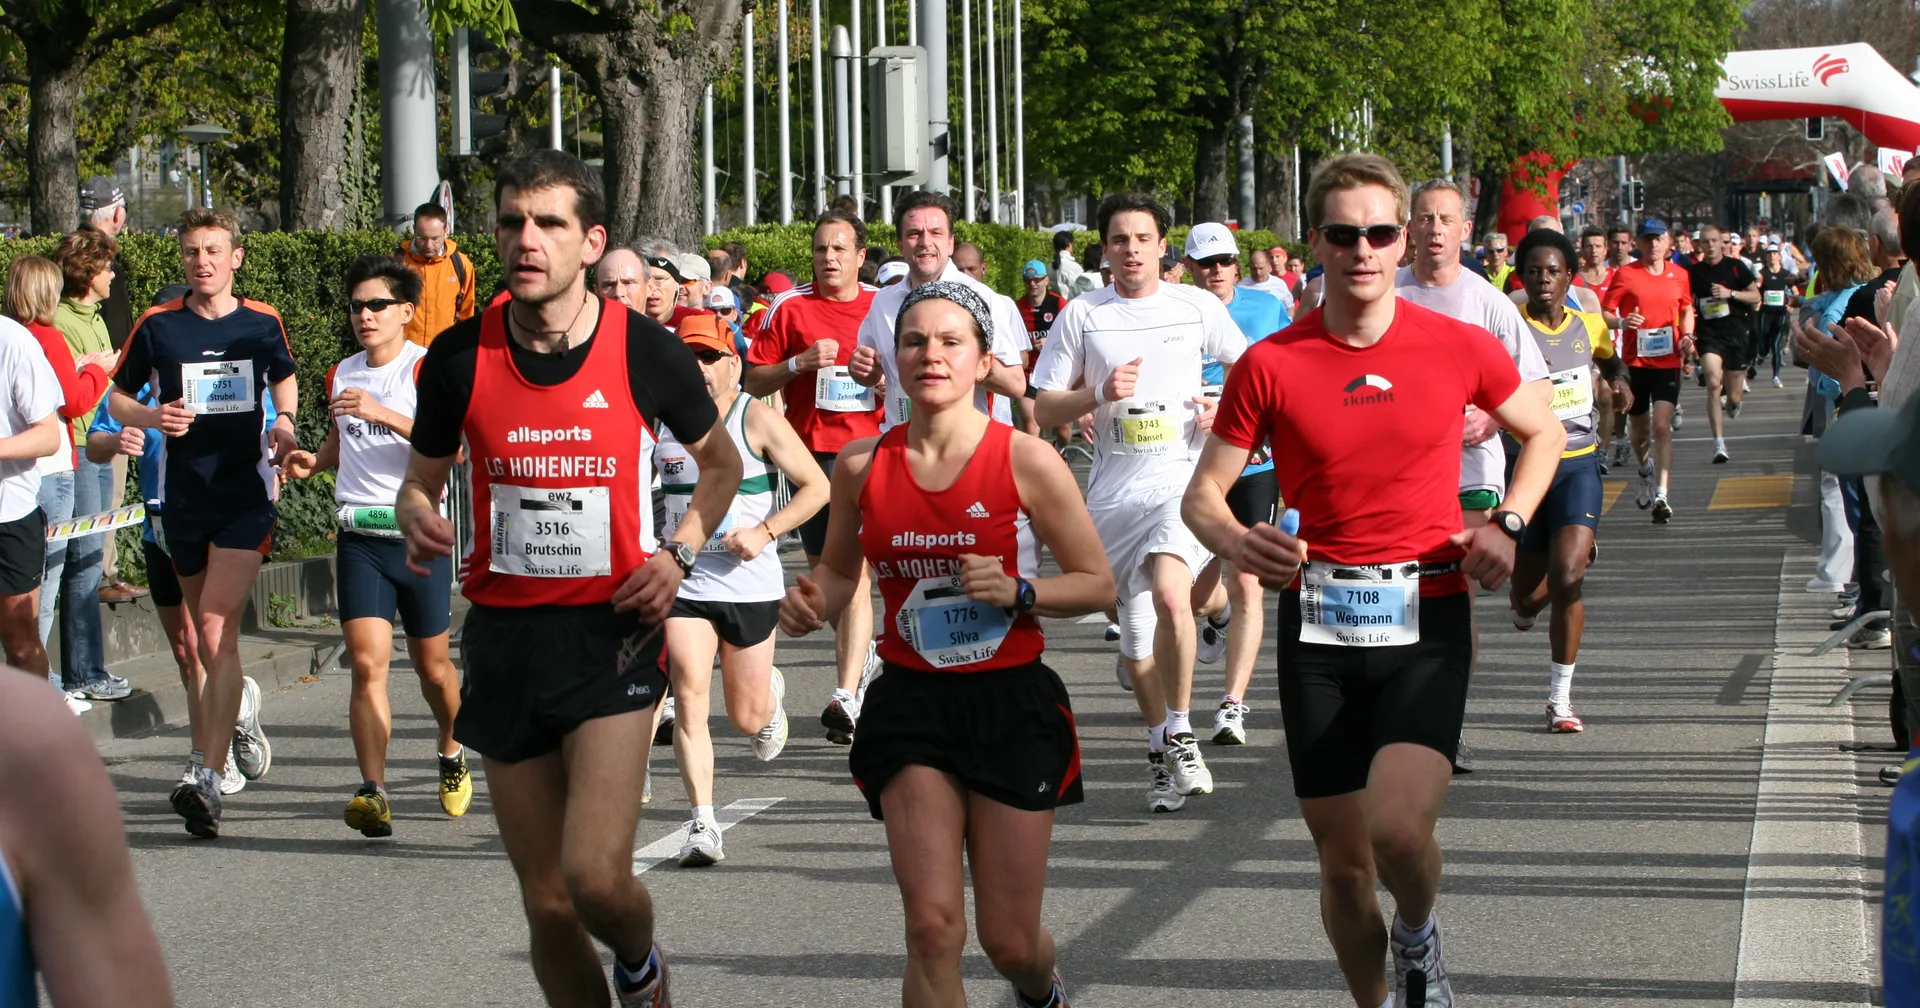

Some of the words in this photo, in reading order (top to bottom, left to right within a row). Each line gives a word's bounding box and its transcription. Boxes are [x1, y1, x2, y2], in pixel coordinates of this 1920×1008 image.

[1729, 71, 1810, 91] SwissLife
[213, 380, 232, 389] 6751
[210, 392, 236, 401] Strubel
[1343, 392, 1395, 407] skinfit
[1558, 387, 1574, 398] 1597
[226, 404, 239, 412] Life
[1138, 419, 1160, 430] 3743
[507, 425, 592, 445] allsports
[1137, 433, 1163, 442] Danset
[1133, 446, 1153, 454] Swiss
[484, 457, 505, 476] LG
[510, 456, 617, 478] HOHENFELS
[548, 491, 572, 501] ewz
[368, 510, 388, 519] 4896
[496, 511, 505, 556] MARATHON
[535, 521, 570, 536] 3516
[710, 543, 725, 551] Life
[892, 531, 976, 549] allsports
[525, 542, 582, 556] Brutschin
[524, 563, 556, 575] Swiss
[558, 564, 582, 575] Life
[873, 560, 893, 579] LG
[1306, 583, 1316, 625] MARATHON
[1347, 590, 1380, 605] 7108
[944, 606, 978, 624] 1776
[1335, 611, 1393, 627] Wegmann
[949, 631, 980, 645] Silva
[1336, 632, 1366, 643] Swiss
[1368, 634, 1390, 643] Life
[938, 652, 972, 665] Swiss
[973, 646, 996, 660] Life
